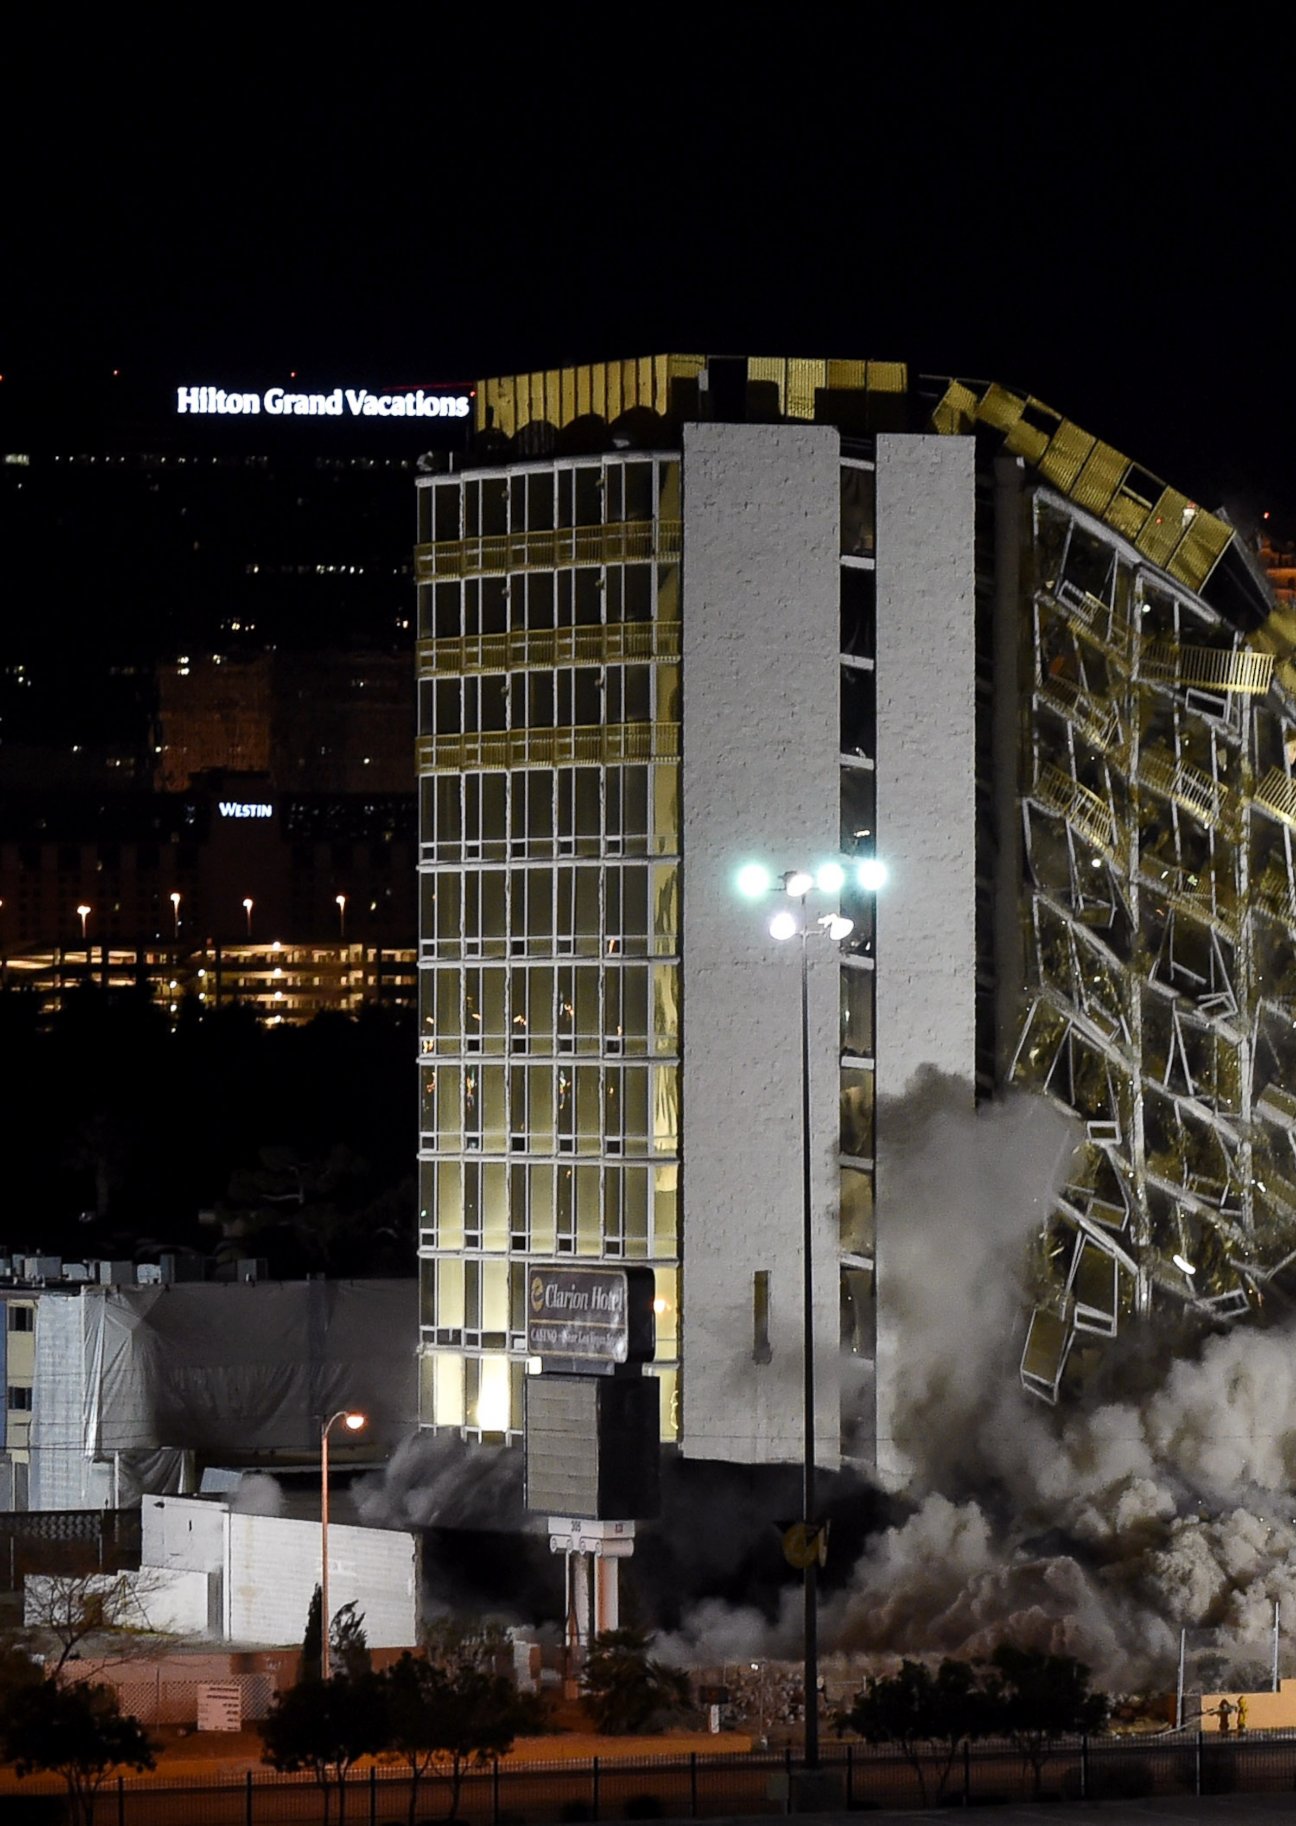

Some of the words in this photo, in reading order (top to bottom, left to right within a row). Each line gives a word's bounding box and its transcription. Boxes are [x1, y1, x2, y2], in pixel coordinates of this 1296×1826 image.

[177, 387, 260, 414] Hilton
[264, 388, 343, 415] Grand
[345, 389, 470, 418] Vacations
[219, 802, 272, 817] WESTIN
[545, 1283, 589, 1310] Clarion
[591, 1285, 623, 1312] Hotel
